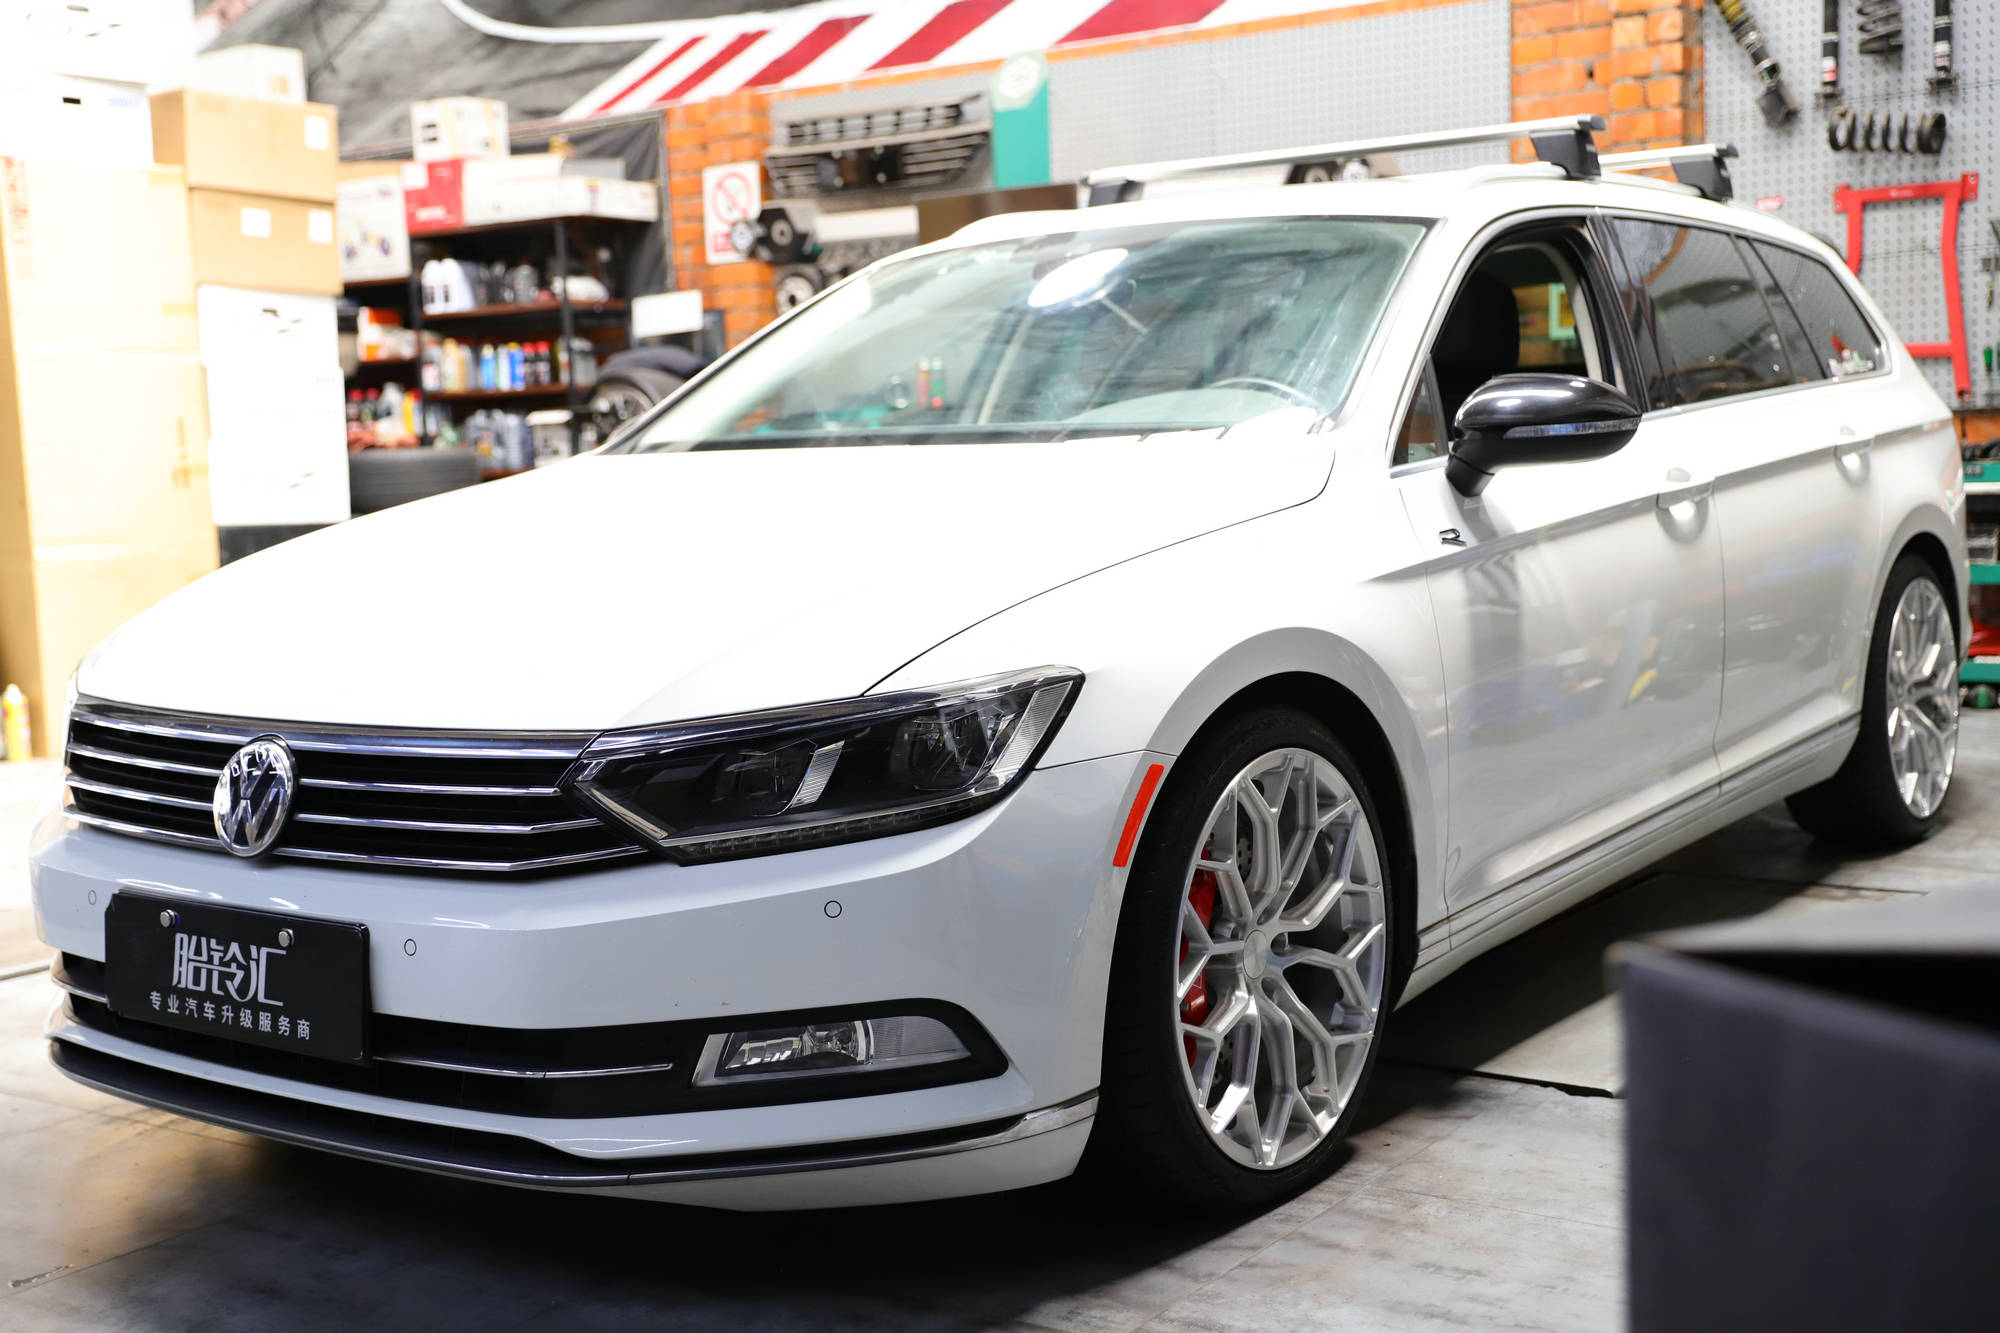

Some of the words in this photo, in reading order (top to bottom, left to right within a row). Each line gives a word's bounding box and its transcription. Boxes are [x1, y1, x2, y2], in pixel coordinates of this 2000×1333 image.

[171, 932, 287, 1007] 胎铃汇
[149, 990, 311, 1041] 专业汽车升级服务商
